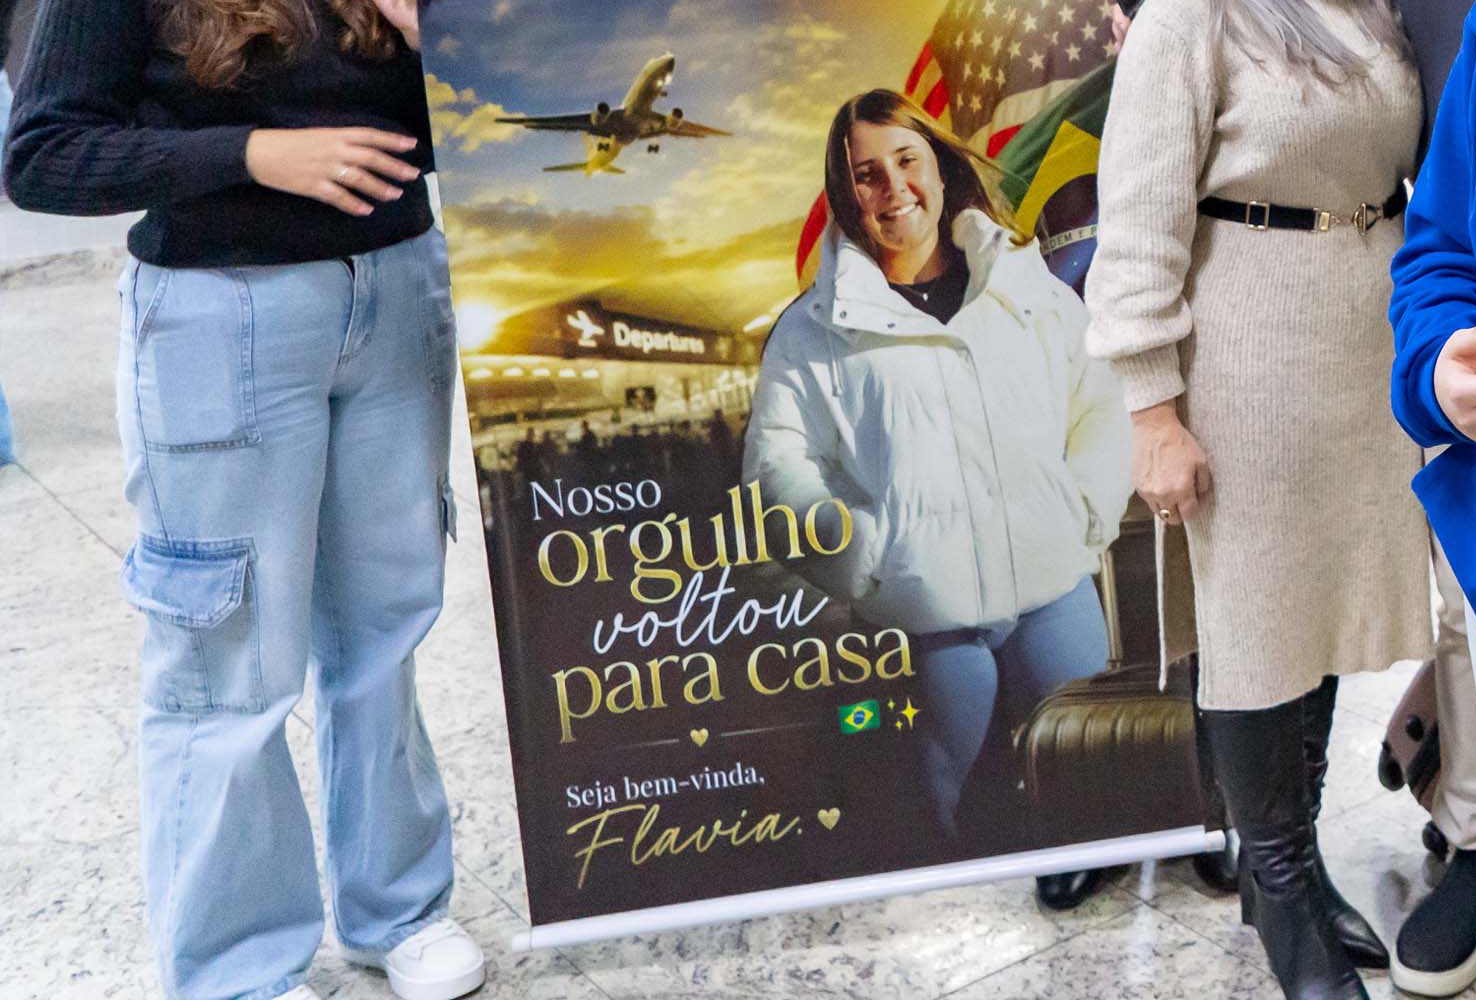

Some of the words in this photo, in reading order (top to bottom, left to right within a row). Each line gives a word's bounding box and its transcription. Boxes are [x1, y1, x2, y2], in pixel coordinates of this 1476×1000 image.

[530, 478, 662, 520] Nosso
[537, 479, 854, 604] orgulho
[592, 566, 829, 655] voltou
[551, 652, 726, 744] para
[746, 627, 916, 696] casa
[565, 780, 617, 808] Seja
[623, 762, 766, 801] bem-vinda,
[565, 803, 803, 889] Flavia.
